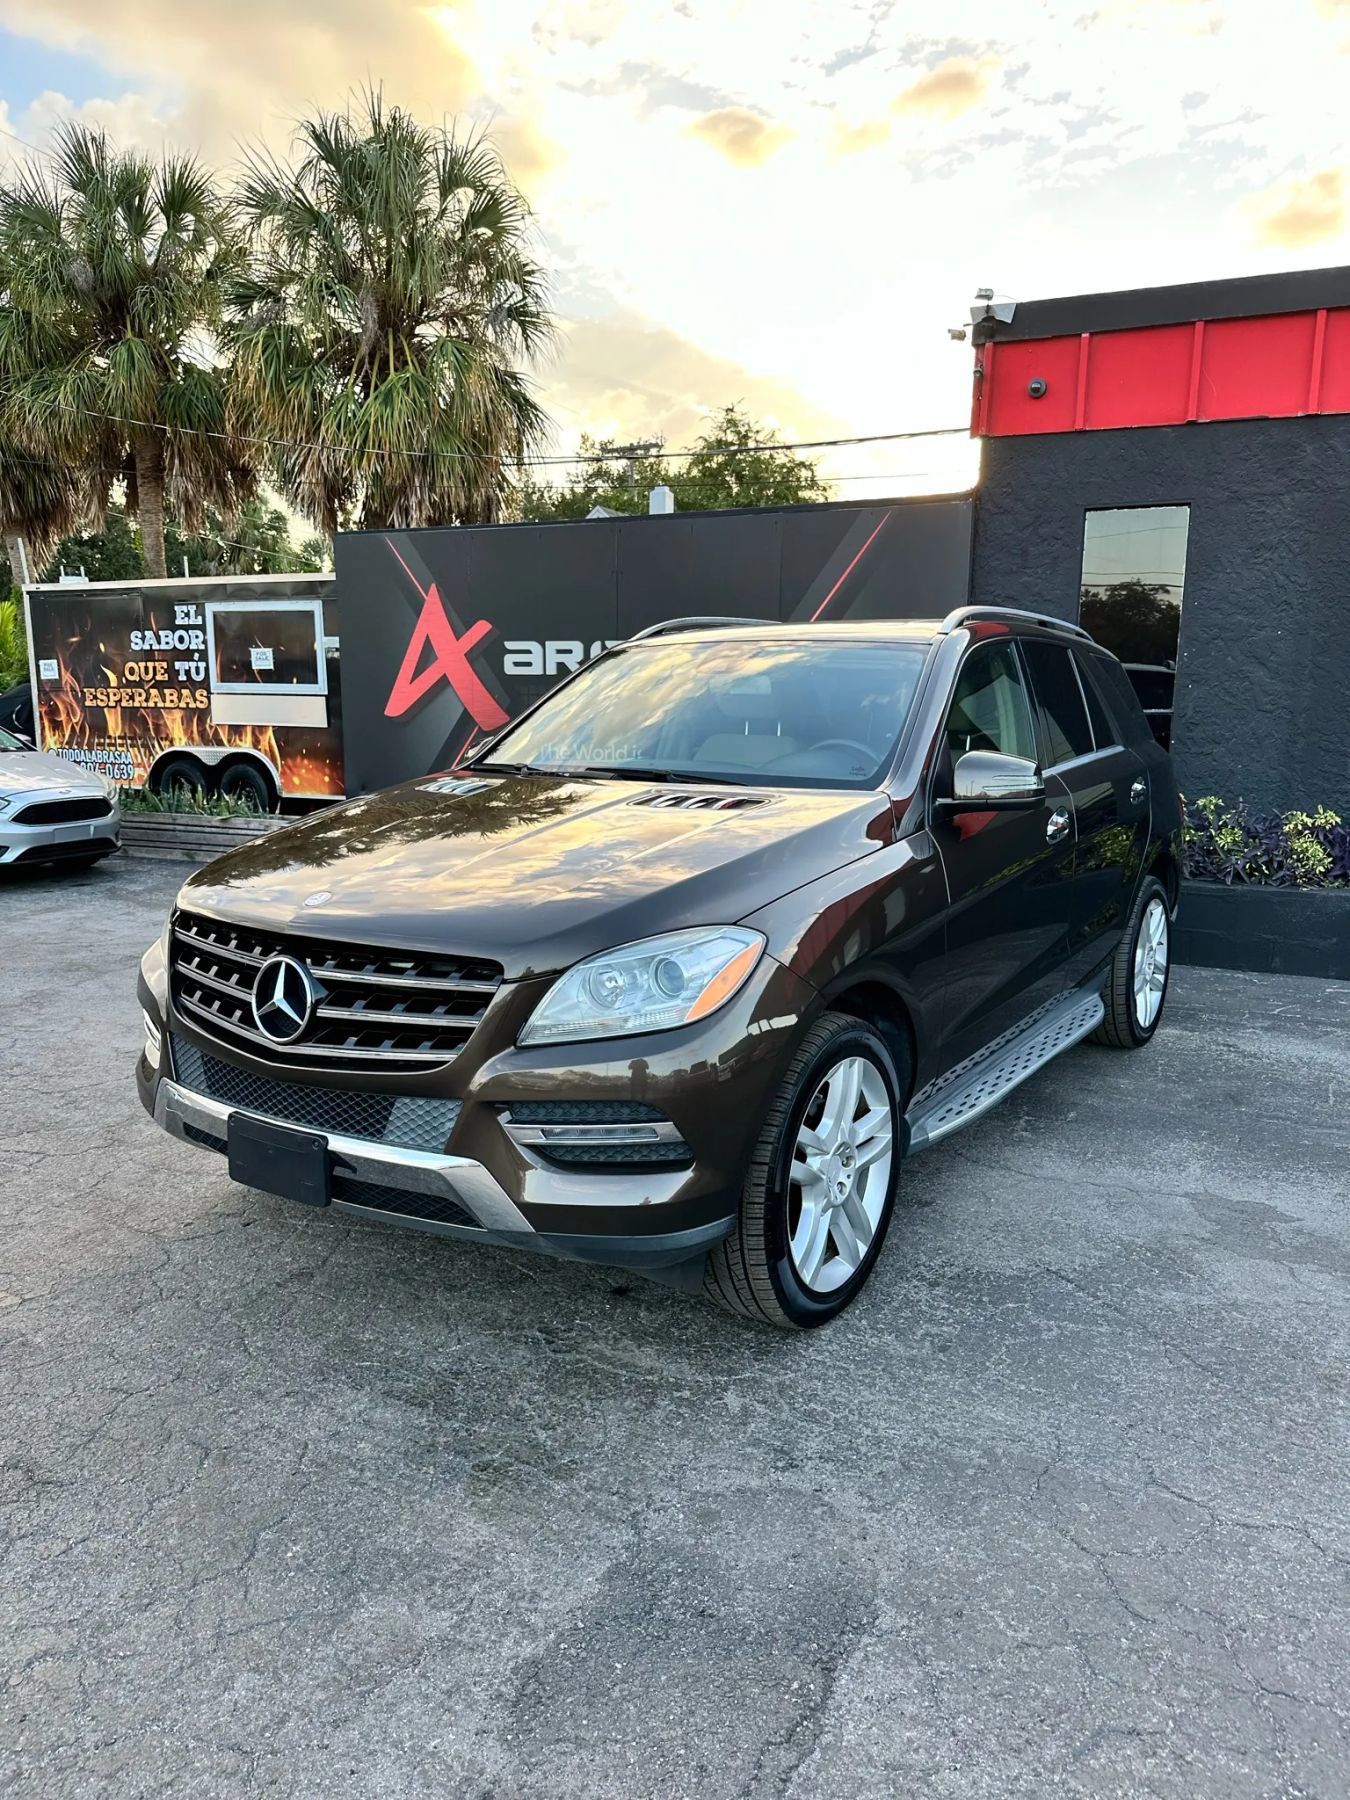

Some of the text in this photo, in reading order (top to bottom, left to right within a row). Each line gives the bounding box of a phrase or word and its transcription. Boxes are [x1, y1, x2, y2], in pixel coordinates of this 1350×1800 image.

[174, 604, 203, 625] EL
[130, 629, 206, 651] SABOR
[124, 652, 207, 682] QUE TÚ
[83, 687, 209, 709] ESPERABAS
[573, 743, 629, 761] World
